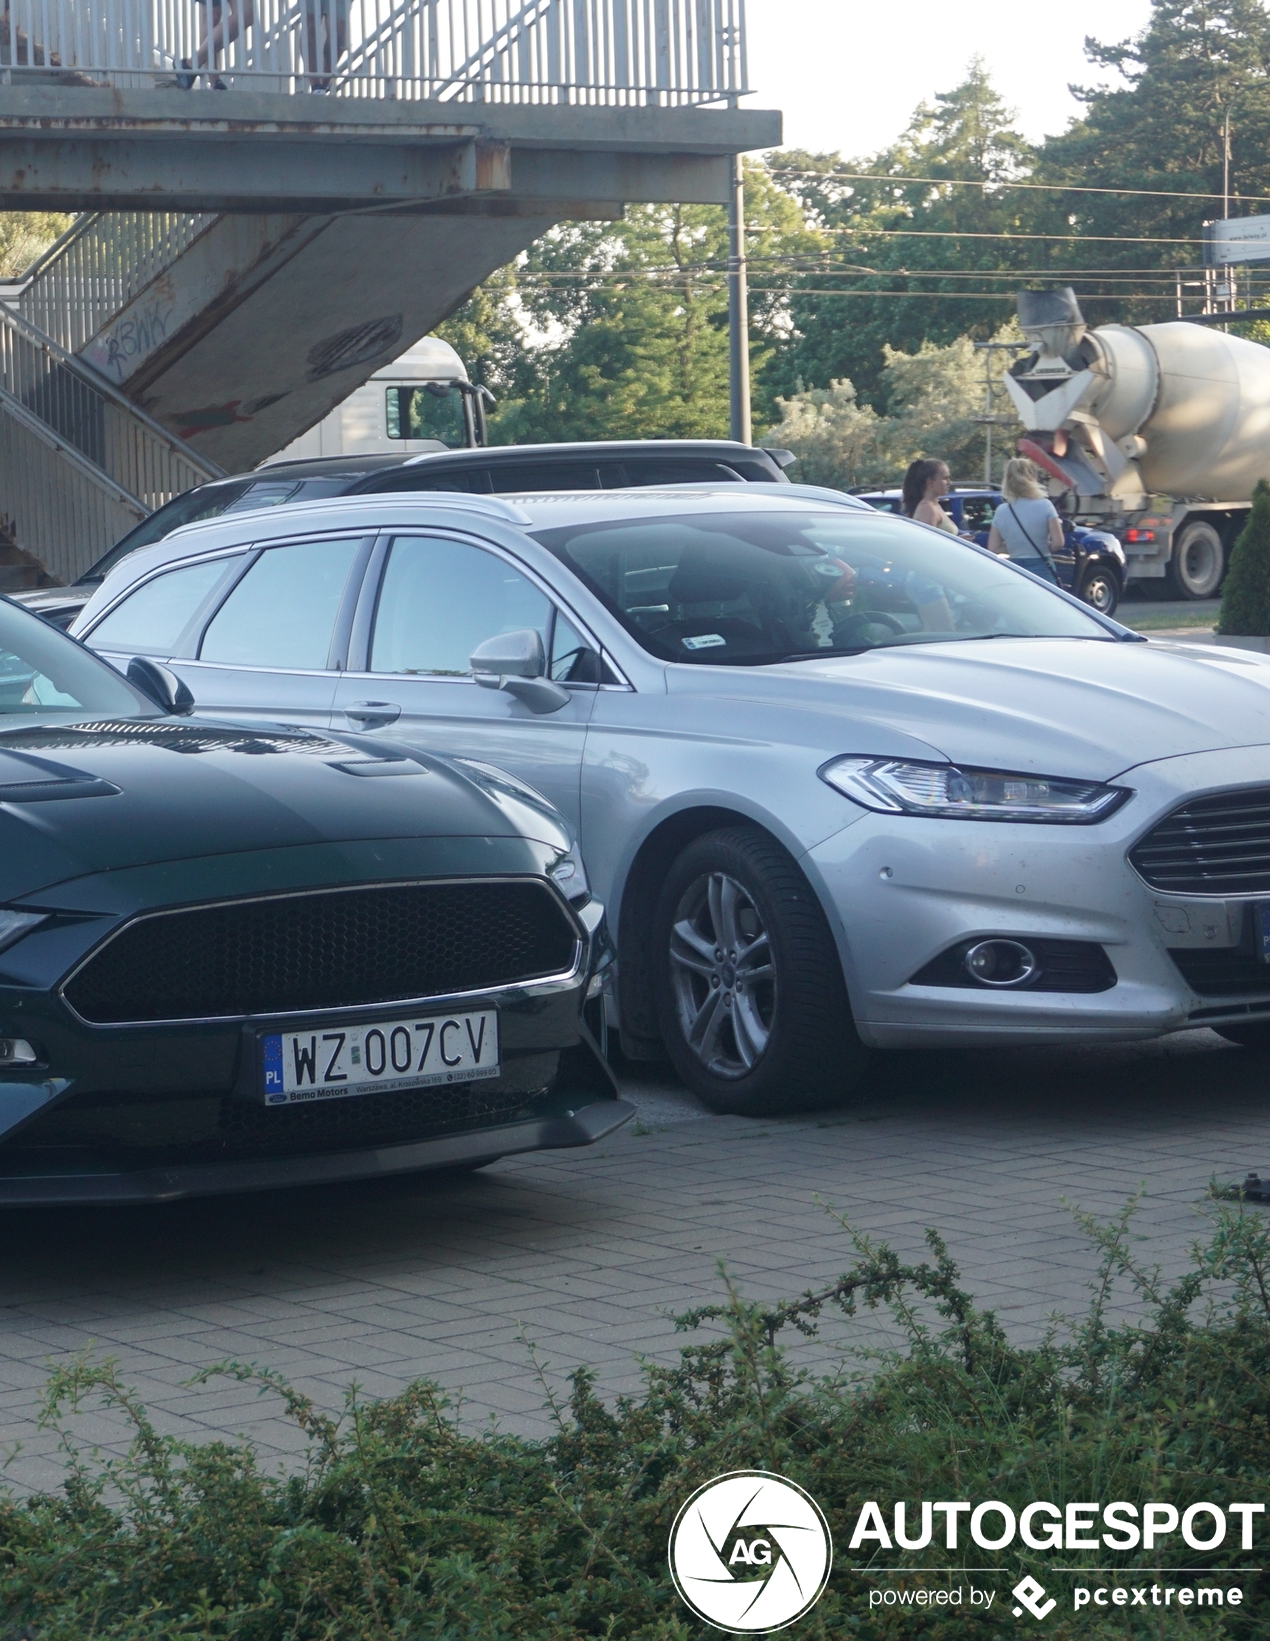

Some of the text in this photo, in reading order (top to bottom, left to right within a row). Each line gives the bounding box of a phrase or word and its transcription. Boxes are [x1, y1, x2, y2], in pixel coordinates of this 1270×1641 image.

[292, 1016, 486, 1086] WZ 007CV
[266, 1070, 281, 1085] PL
[453, 1072, 466, 1080] (22)
[467, 1070, 475, 1078] 60
[476, 1069, 488, 1077] 999
[290, 1092, 316, 1101] Bemo
[317, 1087, 348, 1098] Motors
